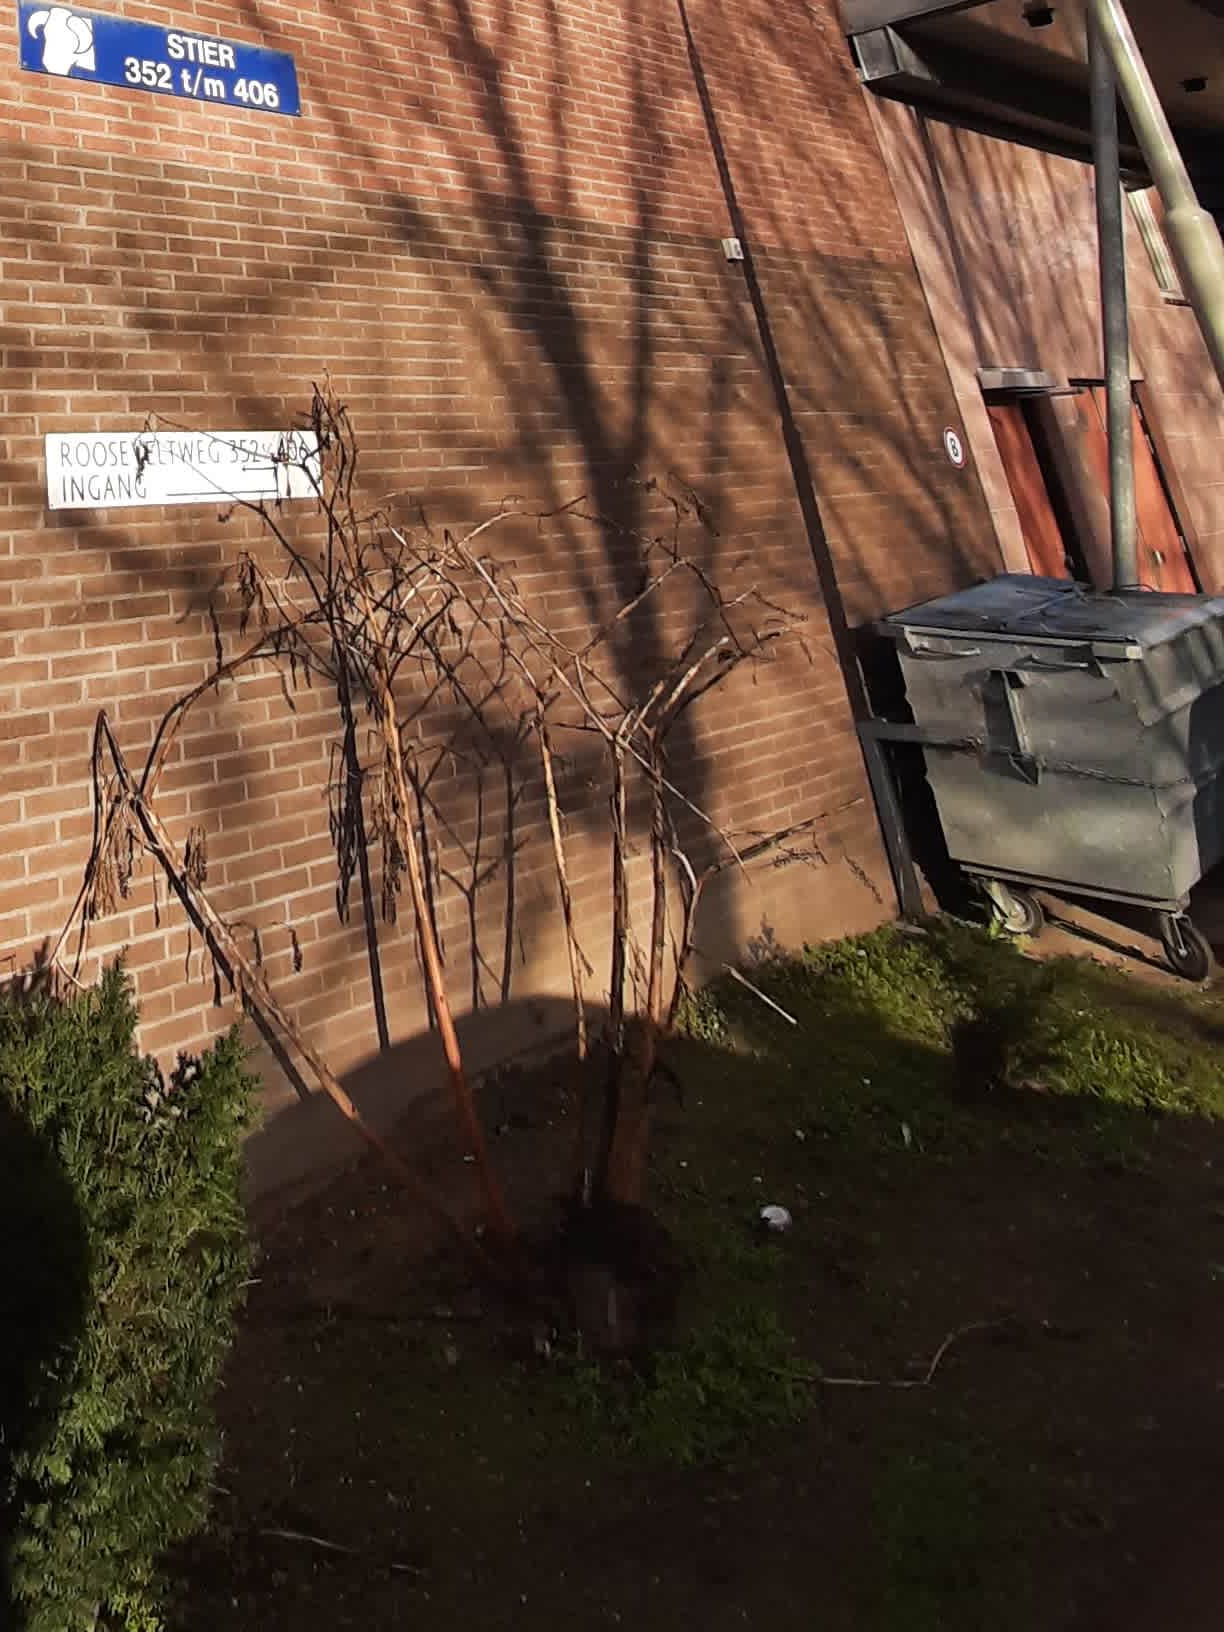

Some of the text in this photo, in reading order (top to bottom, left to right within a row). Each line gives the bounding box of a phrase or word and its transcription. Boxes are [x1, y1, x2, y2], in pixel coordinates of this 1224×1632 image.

[167, 34, 236, 69] STIER
[124, 57, 279, 108] 352 t/m 406
[229, 439, 261, 464] 352
[62, 473, 147, 503] INGANG
